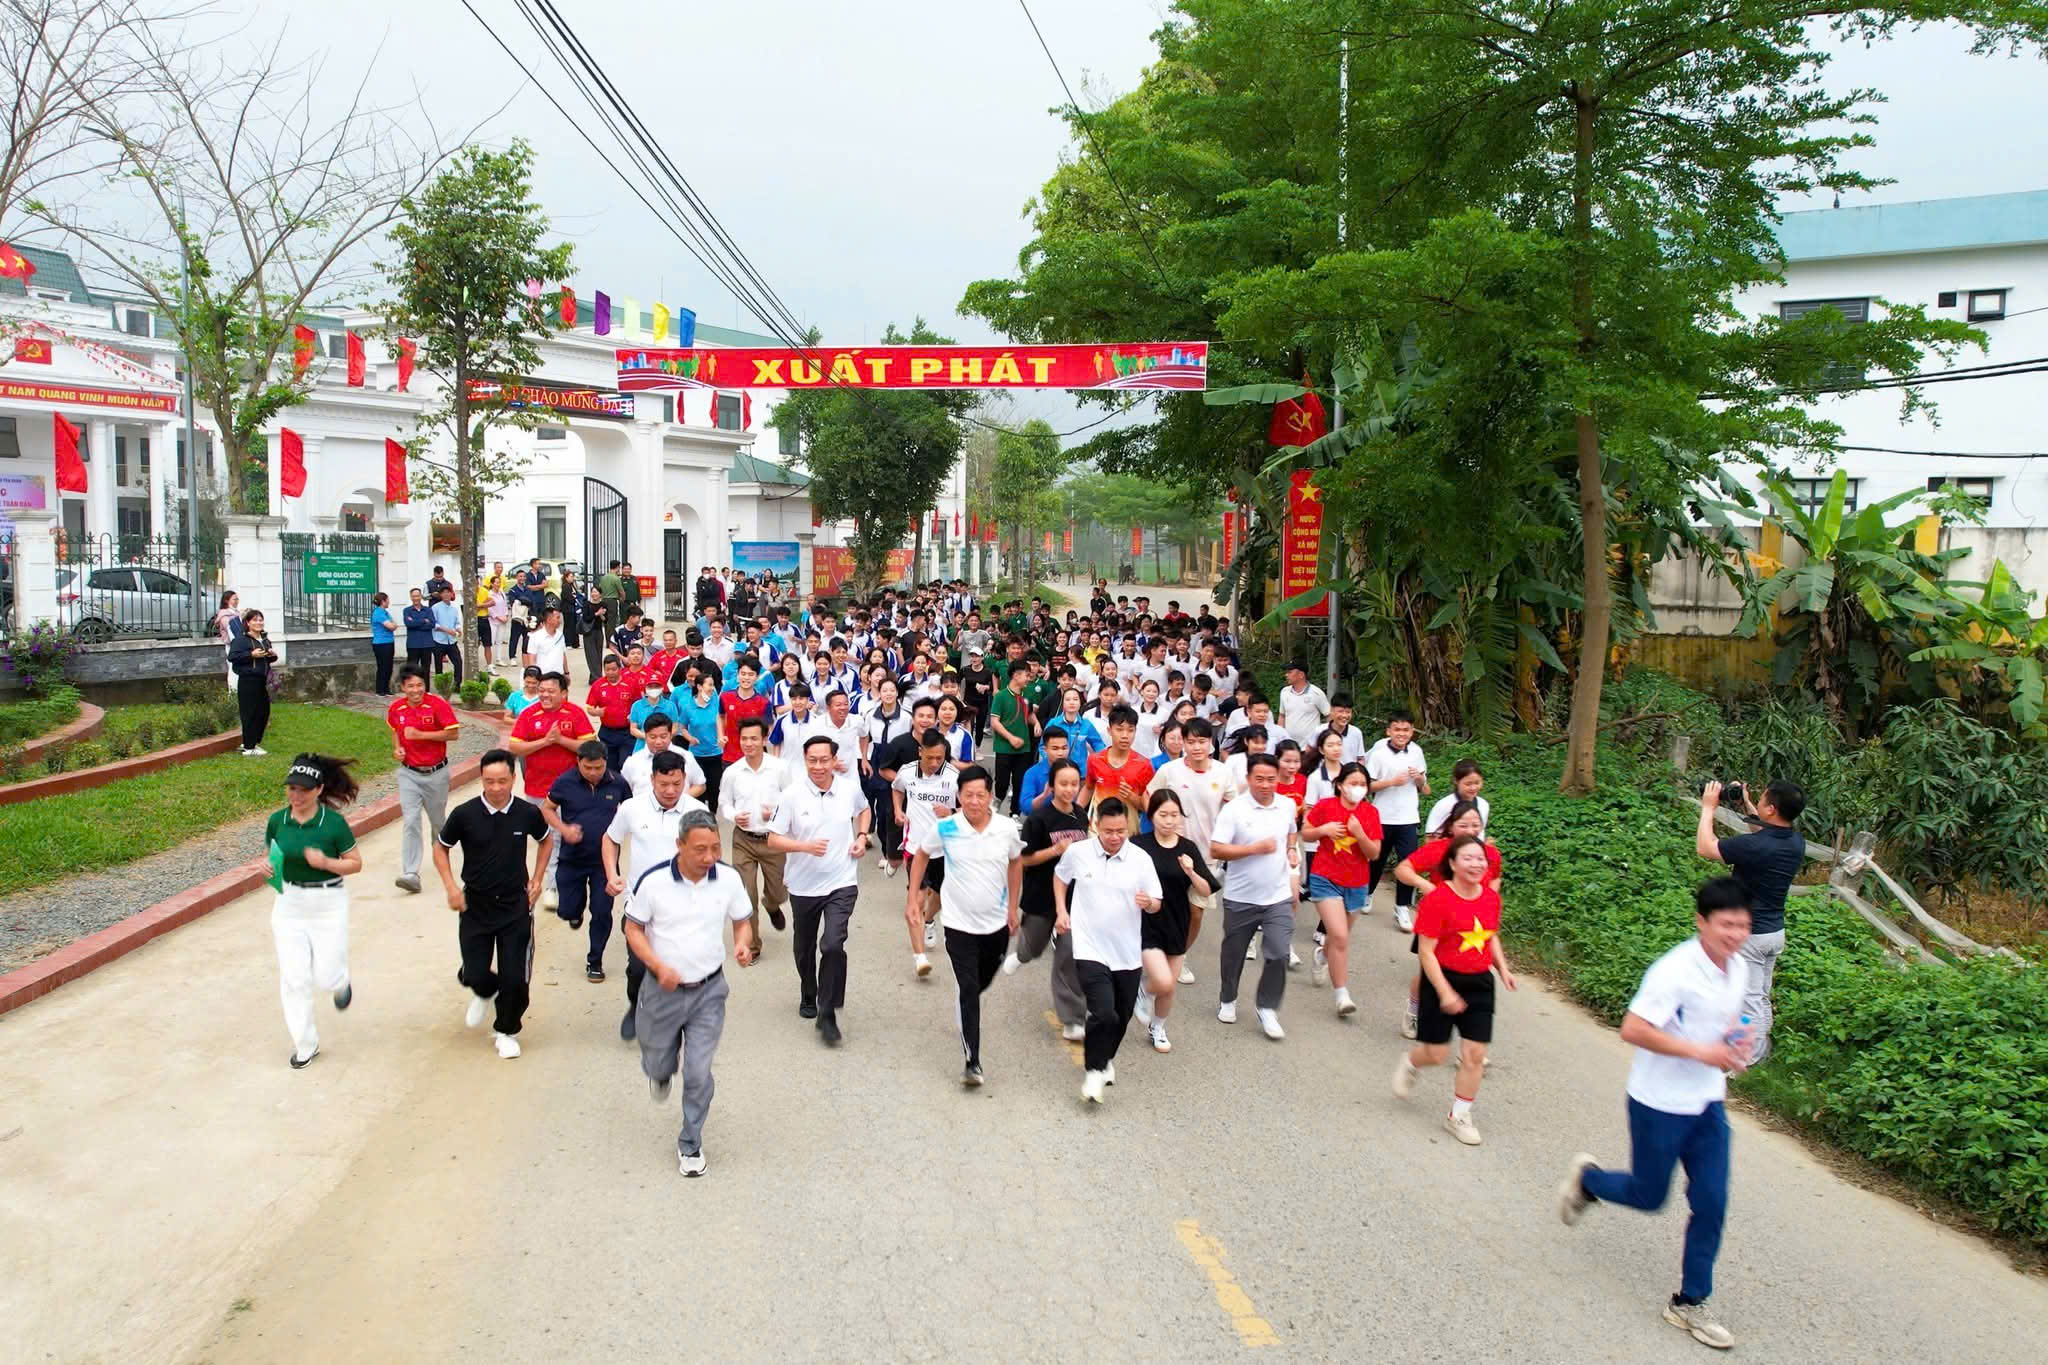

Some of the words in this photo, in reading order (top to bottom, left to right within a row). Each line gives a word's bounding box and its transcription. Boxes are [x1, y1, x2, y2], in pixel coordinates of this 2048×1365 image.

[751, 350, 893, 384] XUẤT
[910, 352, 1057, 383] PHÁT
[8, 385, 35, 397] NAM
[39, 389, 76, 401] QUANG
[79, 393, 104, 403] VINH
[917, 792, 950, 803] SBOTOP
